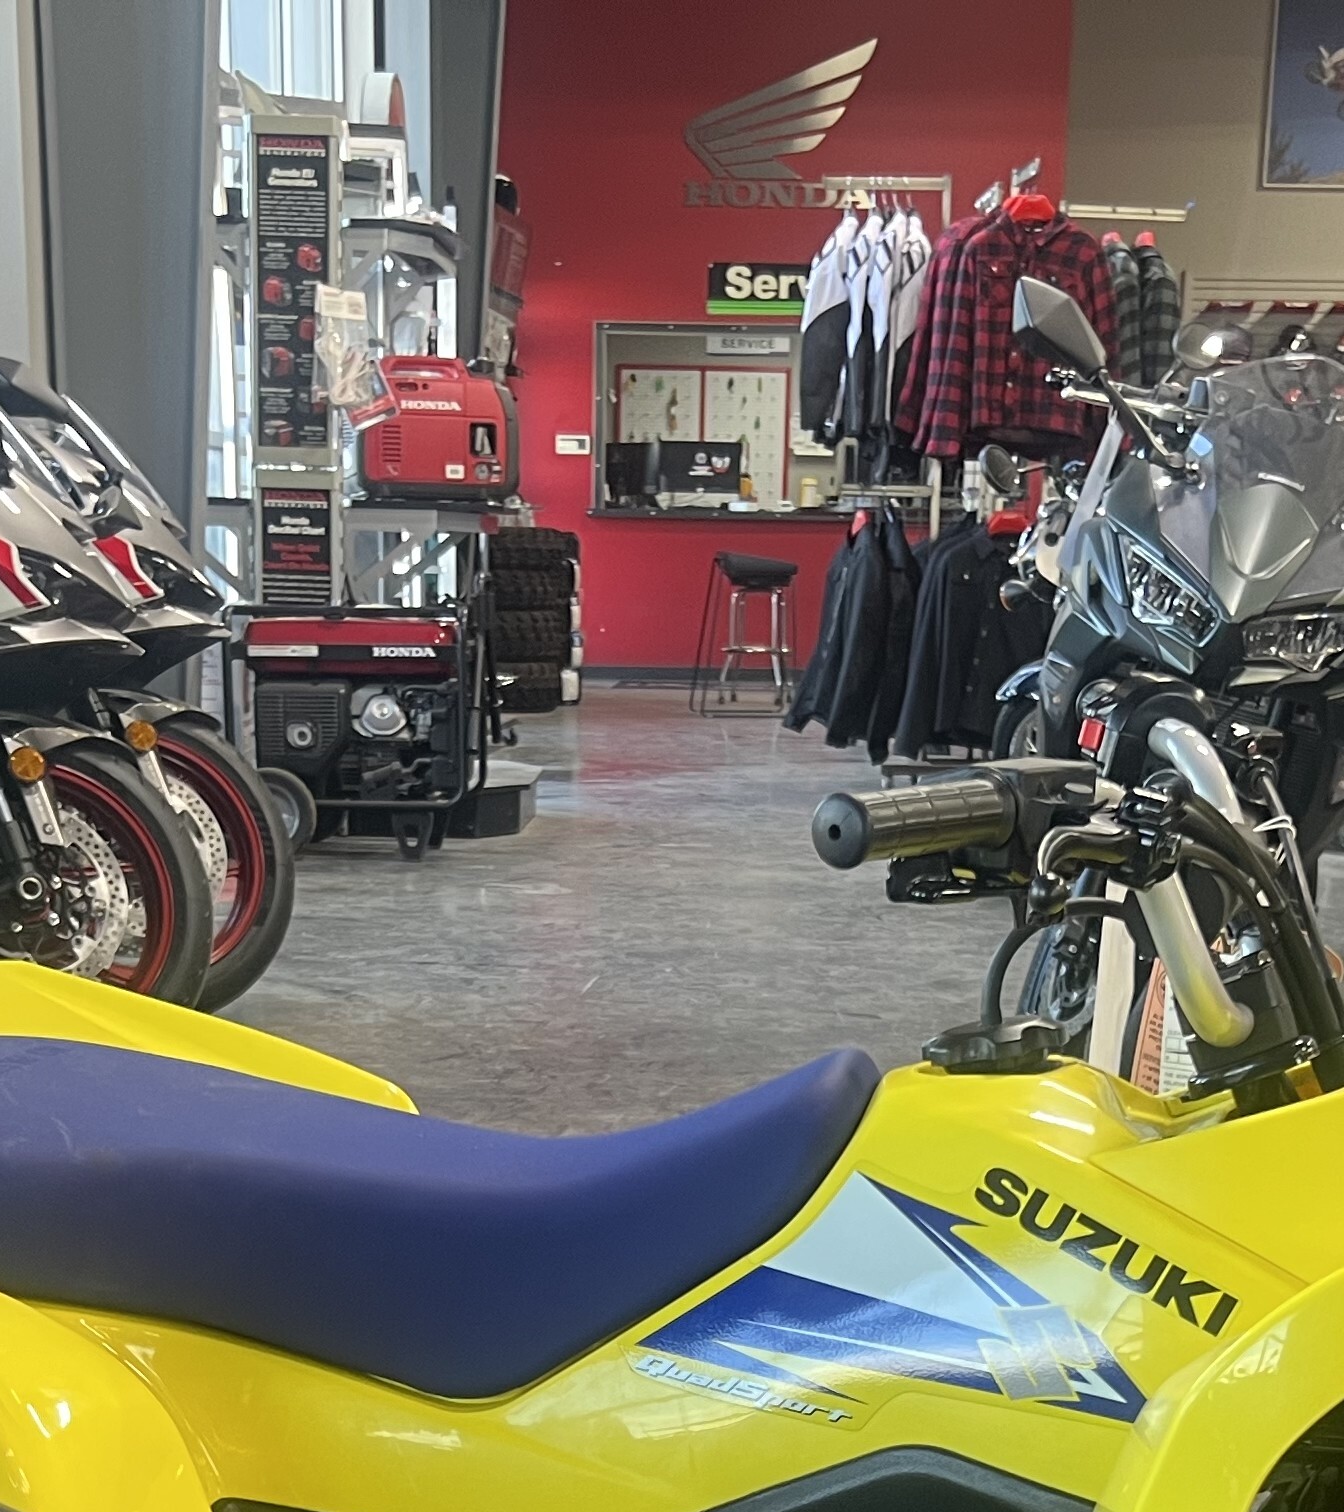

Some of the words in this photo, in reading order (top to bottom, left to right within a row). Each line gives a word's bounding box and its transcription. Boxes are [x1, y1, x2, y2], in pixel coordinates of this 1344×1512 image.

[685, 180, 876, 209] HONDA
[720, 337, 776, 350] SERVICE
[400, 399, 462, 411] HONDA
[372, 647, 437, 658] HONDA
[974, 1167, 1239, 1338] SUZUKI
[636, 1355, 853, 1422] QuadSport
